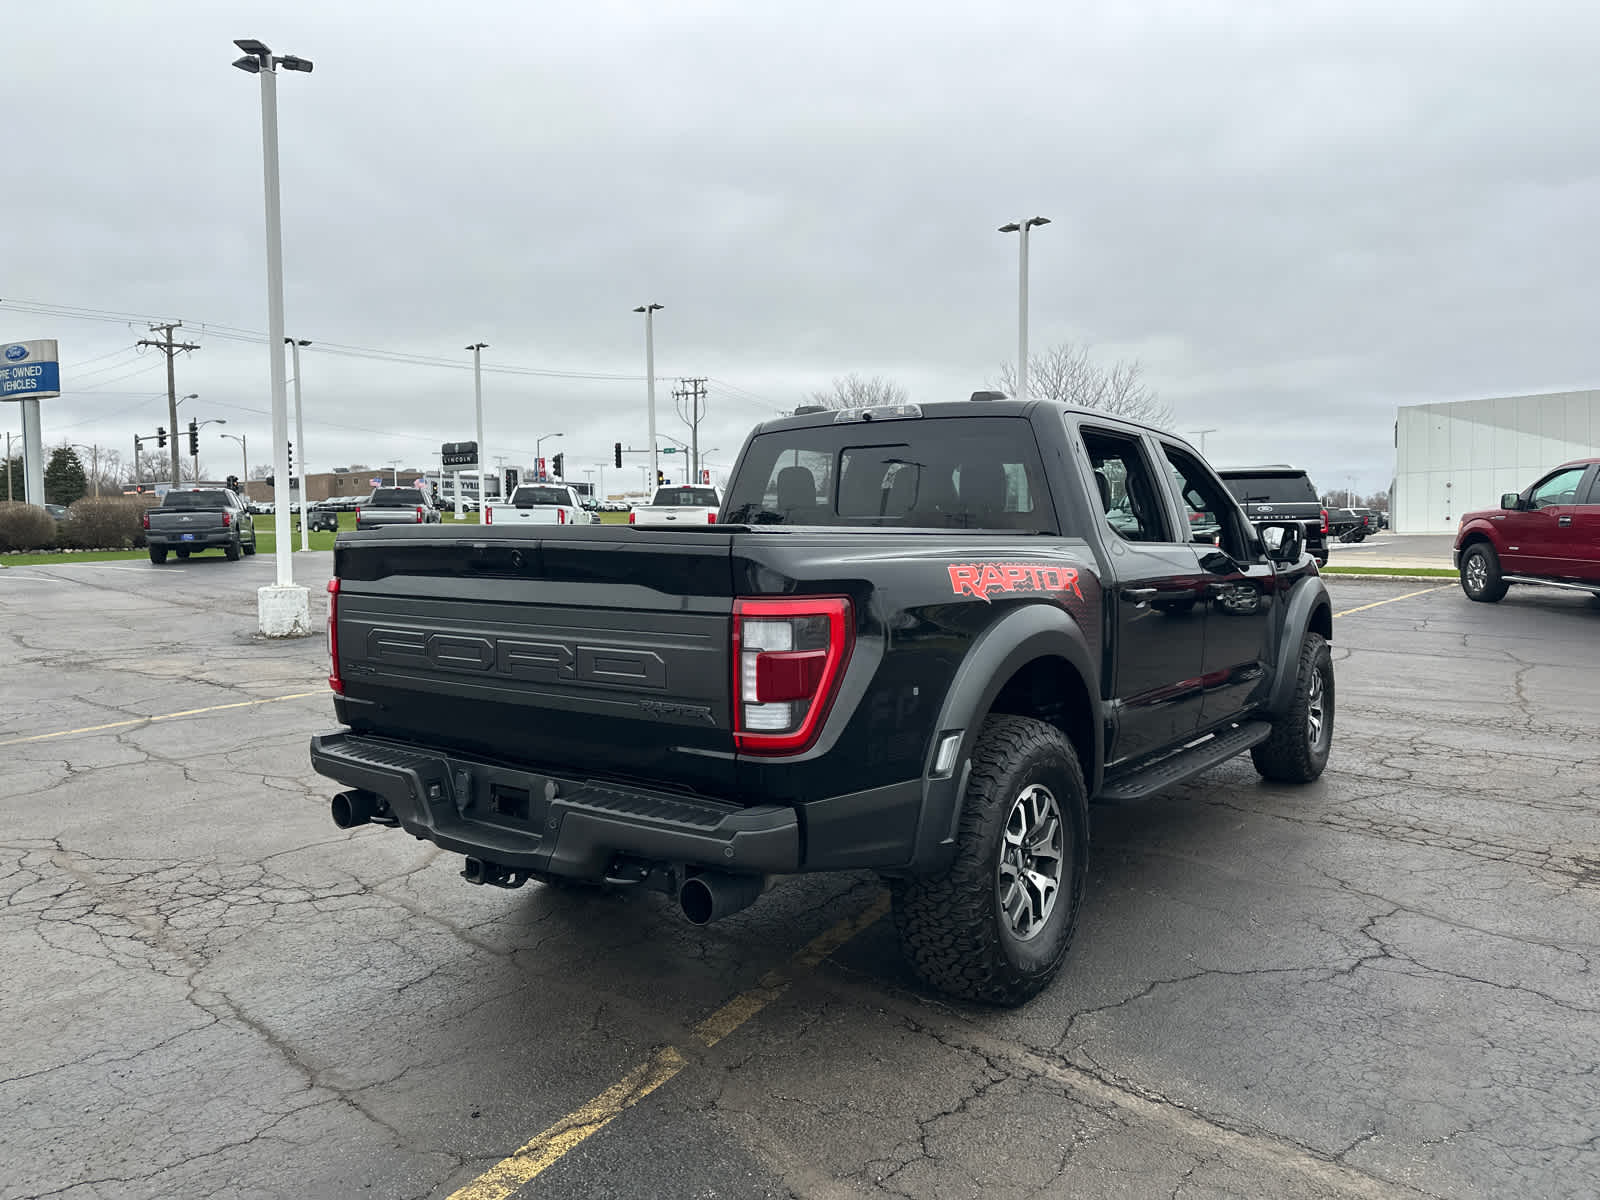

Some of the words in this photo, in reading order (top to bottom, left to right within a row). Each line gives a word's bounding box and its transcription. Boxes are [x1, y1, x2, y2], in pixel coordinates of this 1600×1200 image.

[3, 379, 37, 391] VEHICLES
[443, 456, 471, 464] LINCOLN
[948, 563, 1084, 603] RAPTOR
[367, 628, 667, 690] FORD
